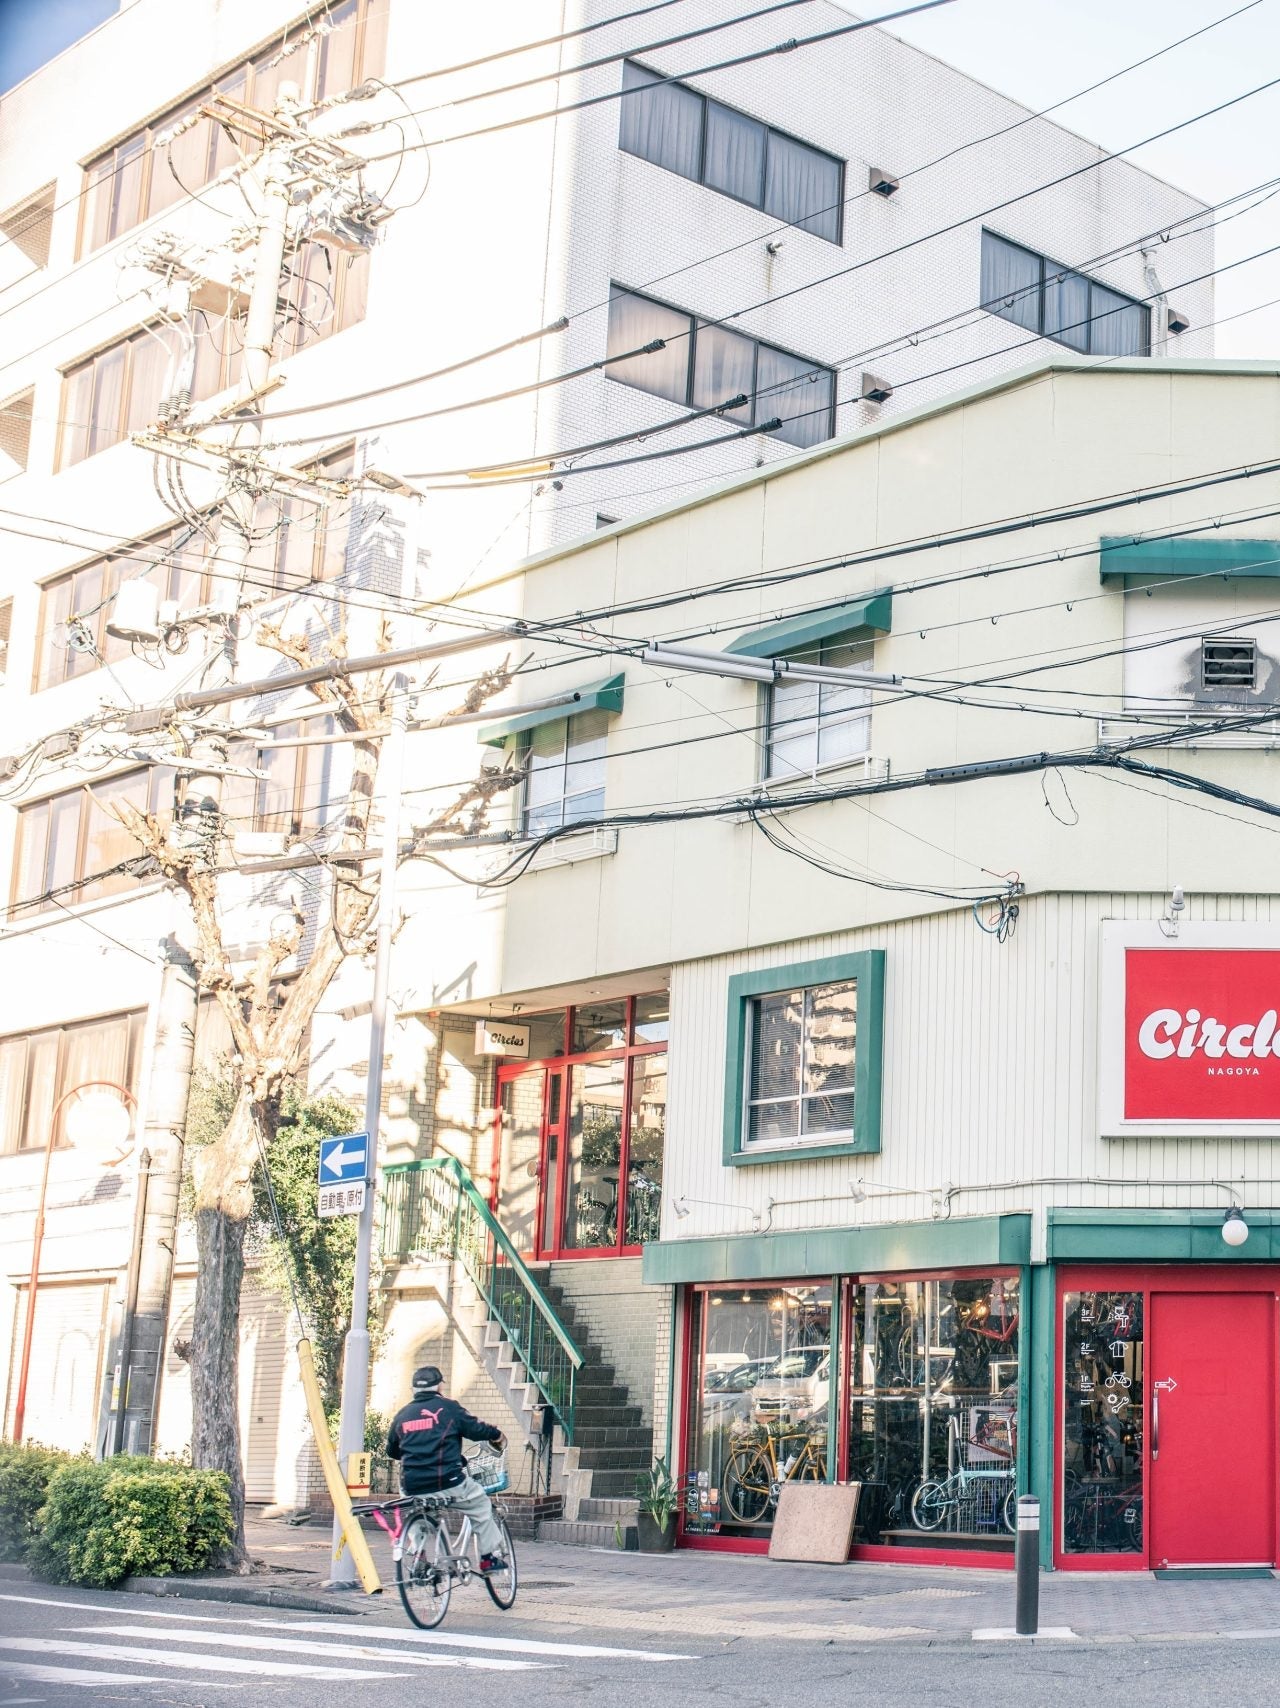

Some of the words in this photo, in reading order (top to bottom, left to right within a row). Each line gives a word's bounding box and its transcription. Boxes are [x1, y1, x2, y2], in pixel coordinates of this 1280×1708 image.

[491, 1033, 524, 1046] Circles
[1208, 1067, 1259, 1075] NAGOYA
[402, 1418, 433, 1433] PUMA
